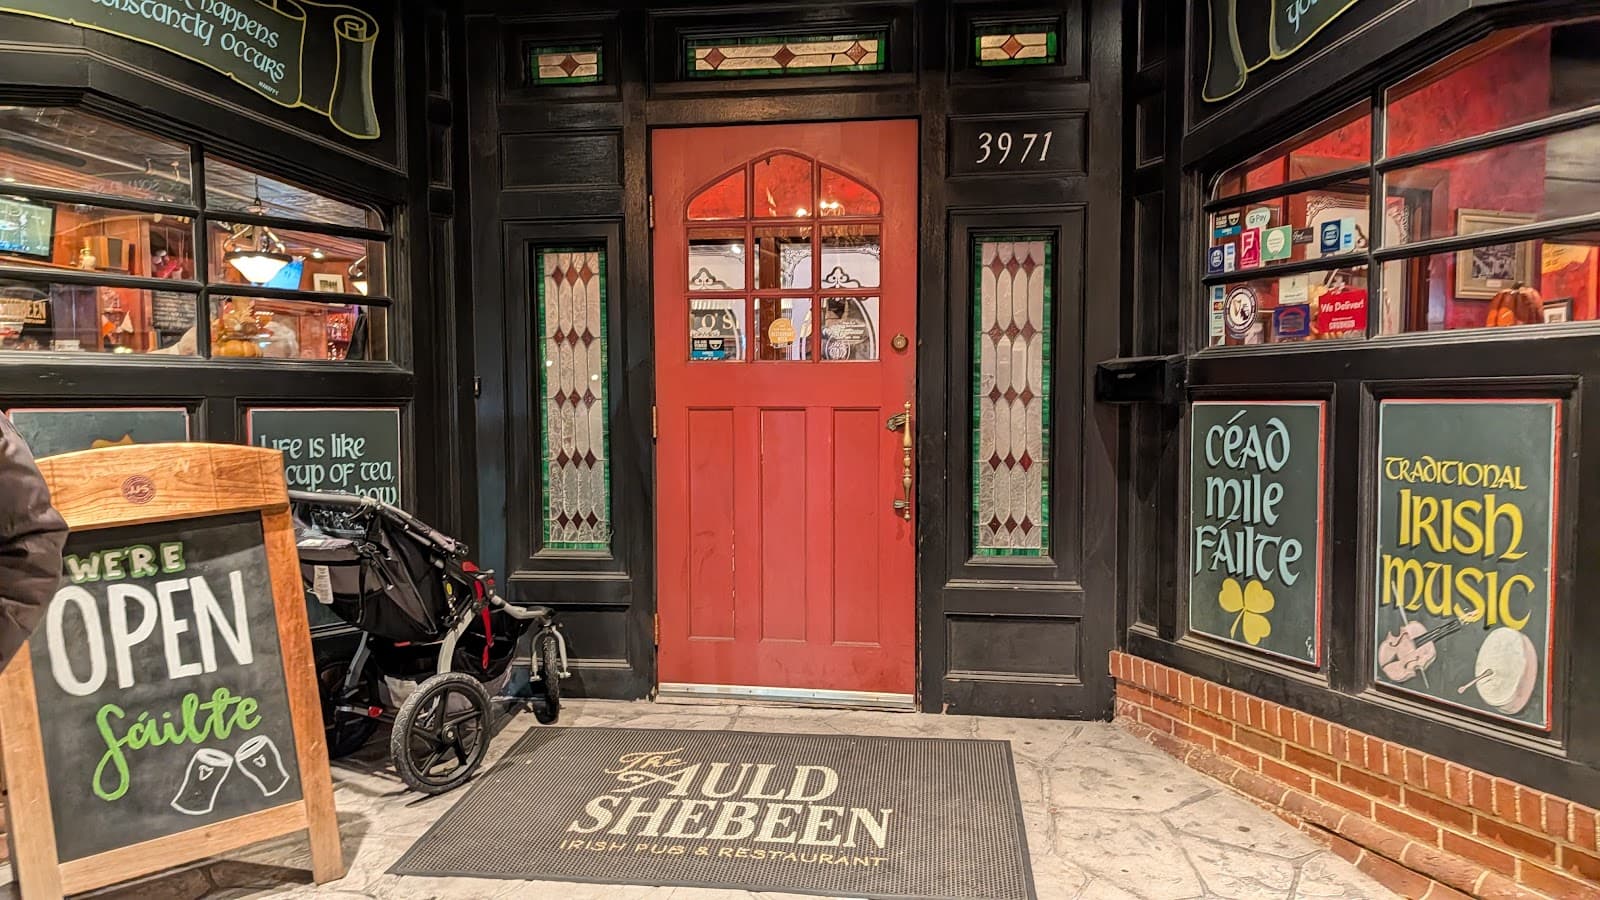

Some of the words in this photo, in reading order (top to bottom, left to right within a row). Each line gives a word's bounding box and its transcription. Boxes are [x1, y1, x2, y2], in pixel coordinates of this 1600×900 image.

[200, 0, 280, 48] happens
[1286, 0, 1318, 34] yo
[91, 0, 214, 46] nstantly
[221, 33, 285, 83] occurs
[976, 131, 1052, 164] 3971
[1321, 303, 1334, 313] We
[1335, 299, 1364, 312] Deliver!
[309, 438, 325, 459] is
[331, 433, 366, 459] like
[329, 462, 355, 487] of
[360, 461, 396, 483] tea,
[64, 541, 187, 583] WE'RE
[46, 570, 255, 697] OPEN
[604, 747, 687, 774] The
[611, 762, 840, 801] AULD
[567, 795, 893, 850] SHEBEEN
[559, 839, 625, 852] IRISH
[635, 843, 684, 855] PUB
[694, 846, 709, 857] &
[717, 847, 889, 867] RESTAURANT
